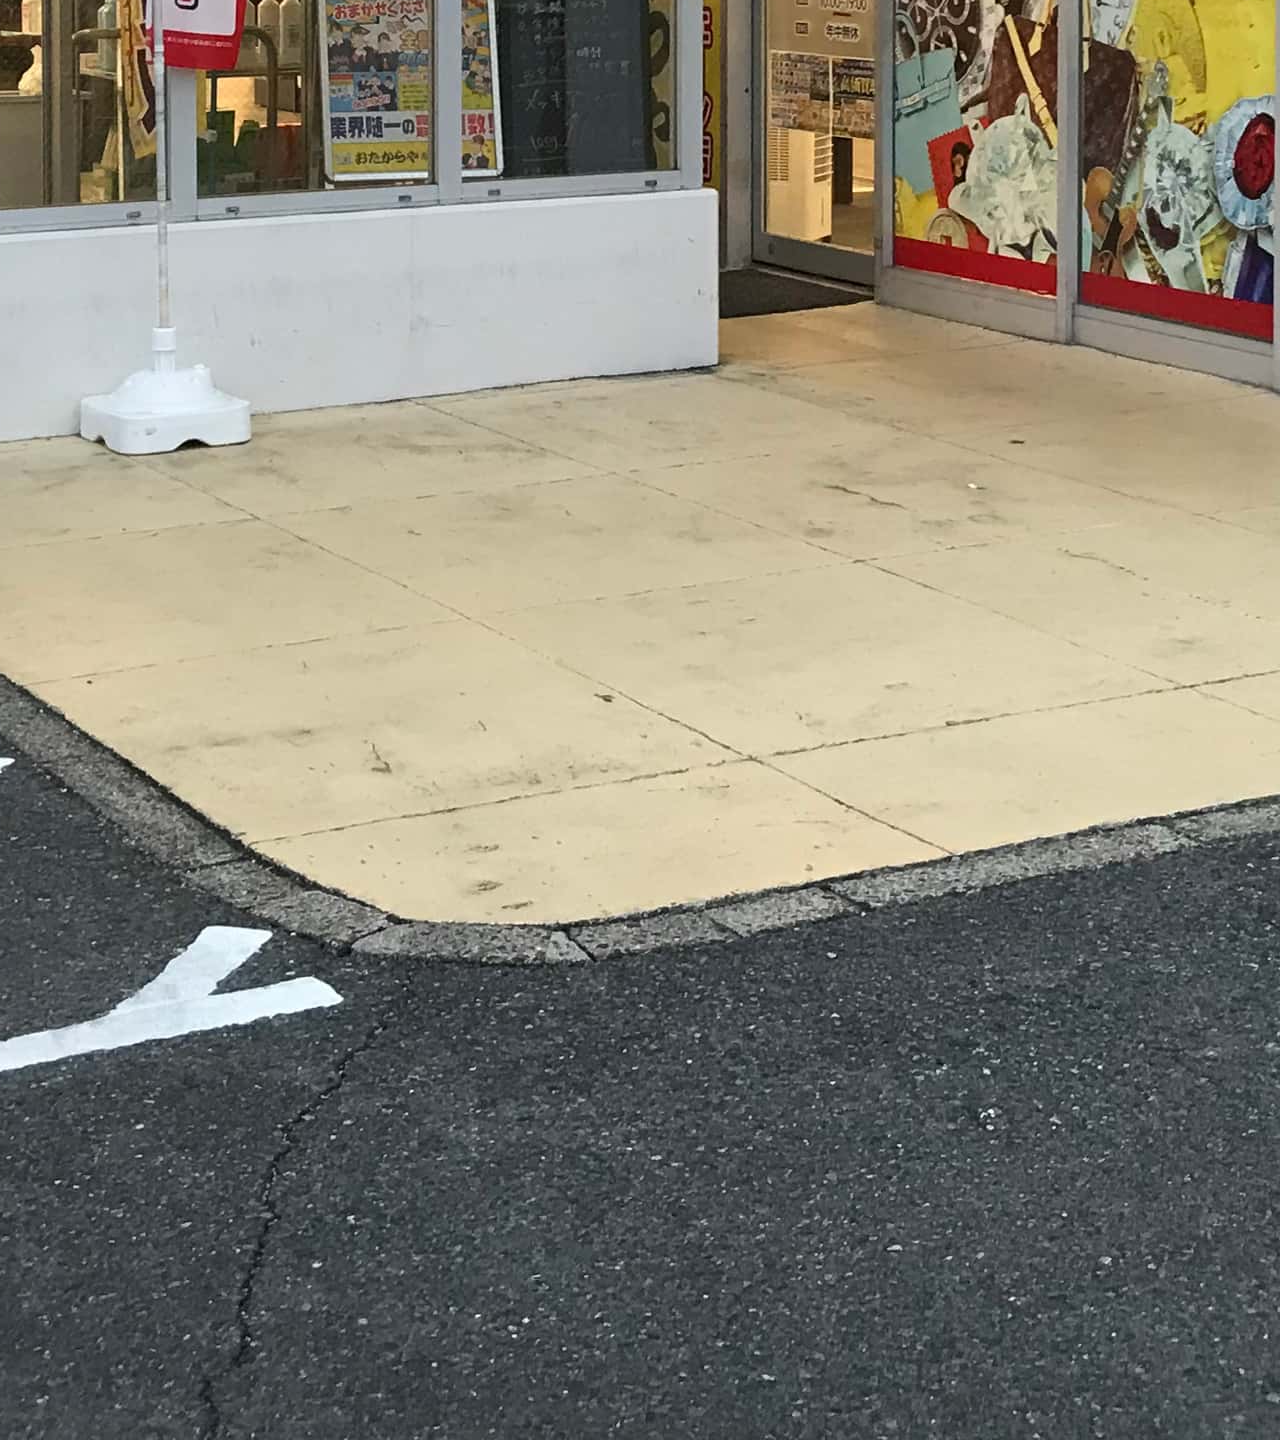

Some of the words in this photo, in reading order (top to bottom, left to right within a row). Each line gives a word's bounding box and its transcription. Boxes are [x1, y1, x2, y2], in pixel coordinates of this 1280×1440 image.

[334, 0, 427, 19] おまかせくださ
[825, 24, 859, 40] 年中無休
[354, 147, 420, 166] おたからや
